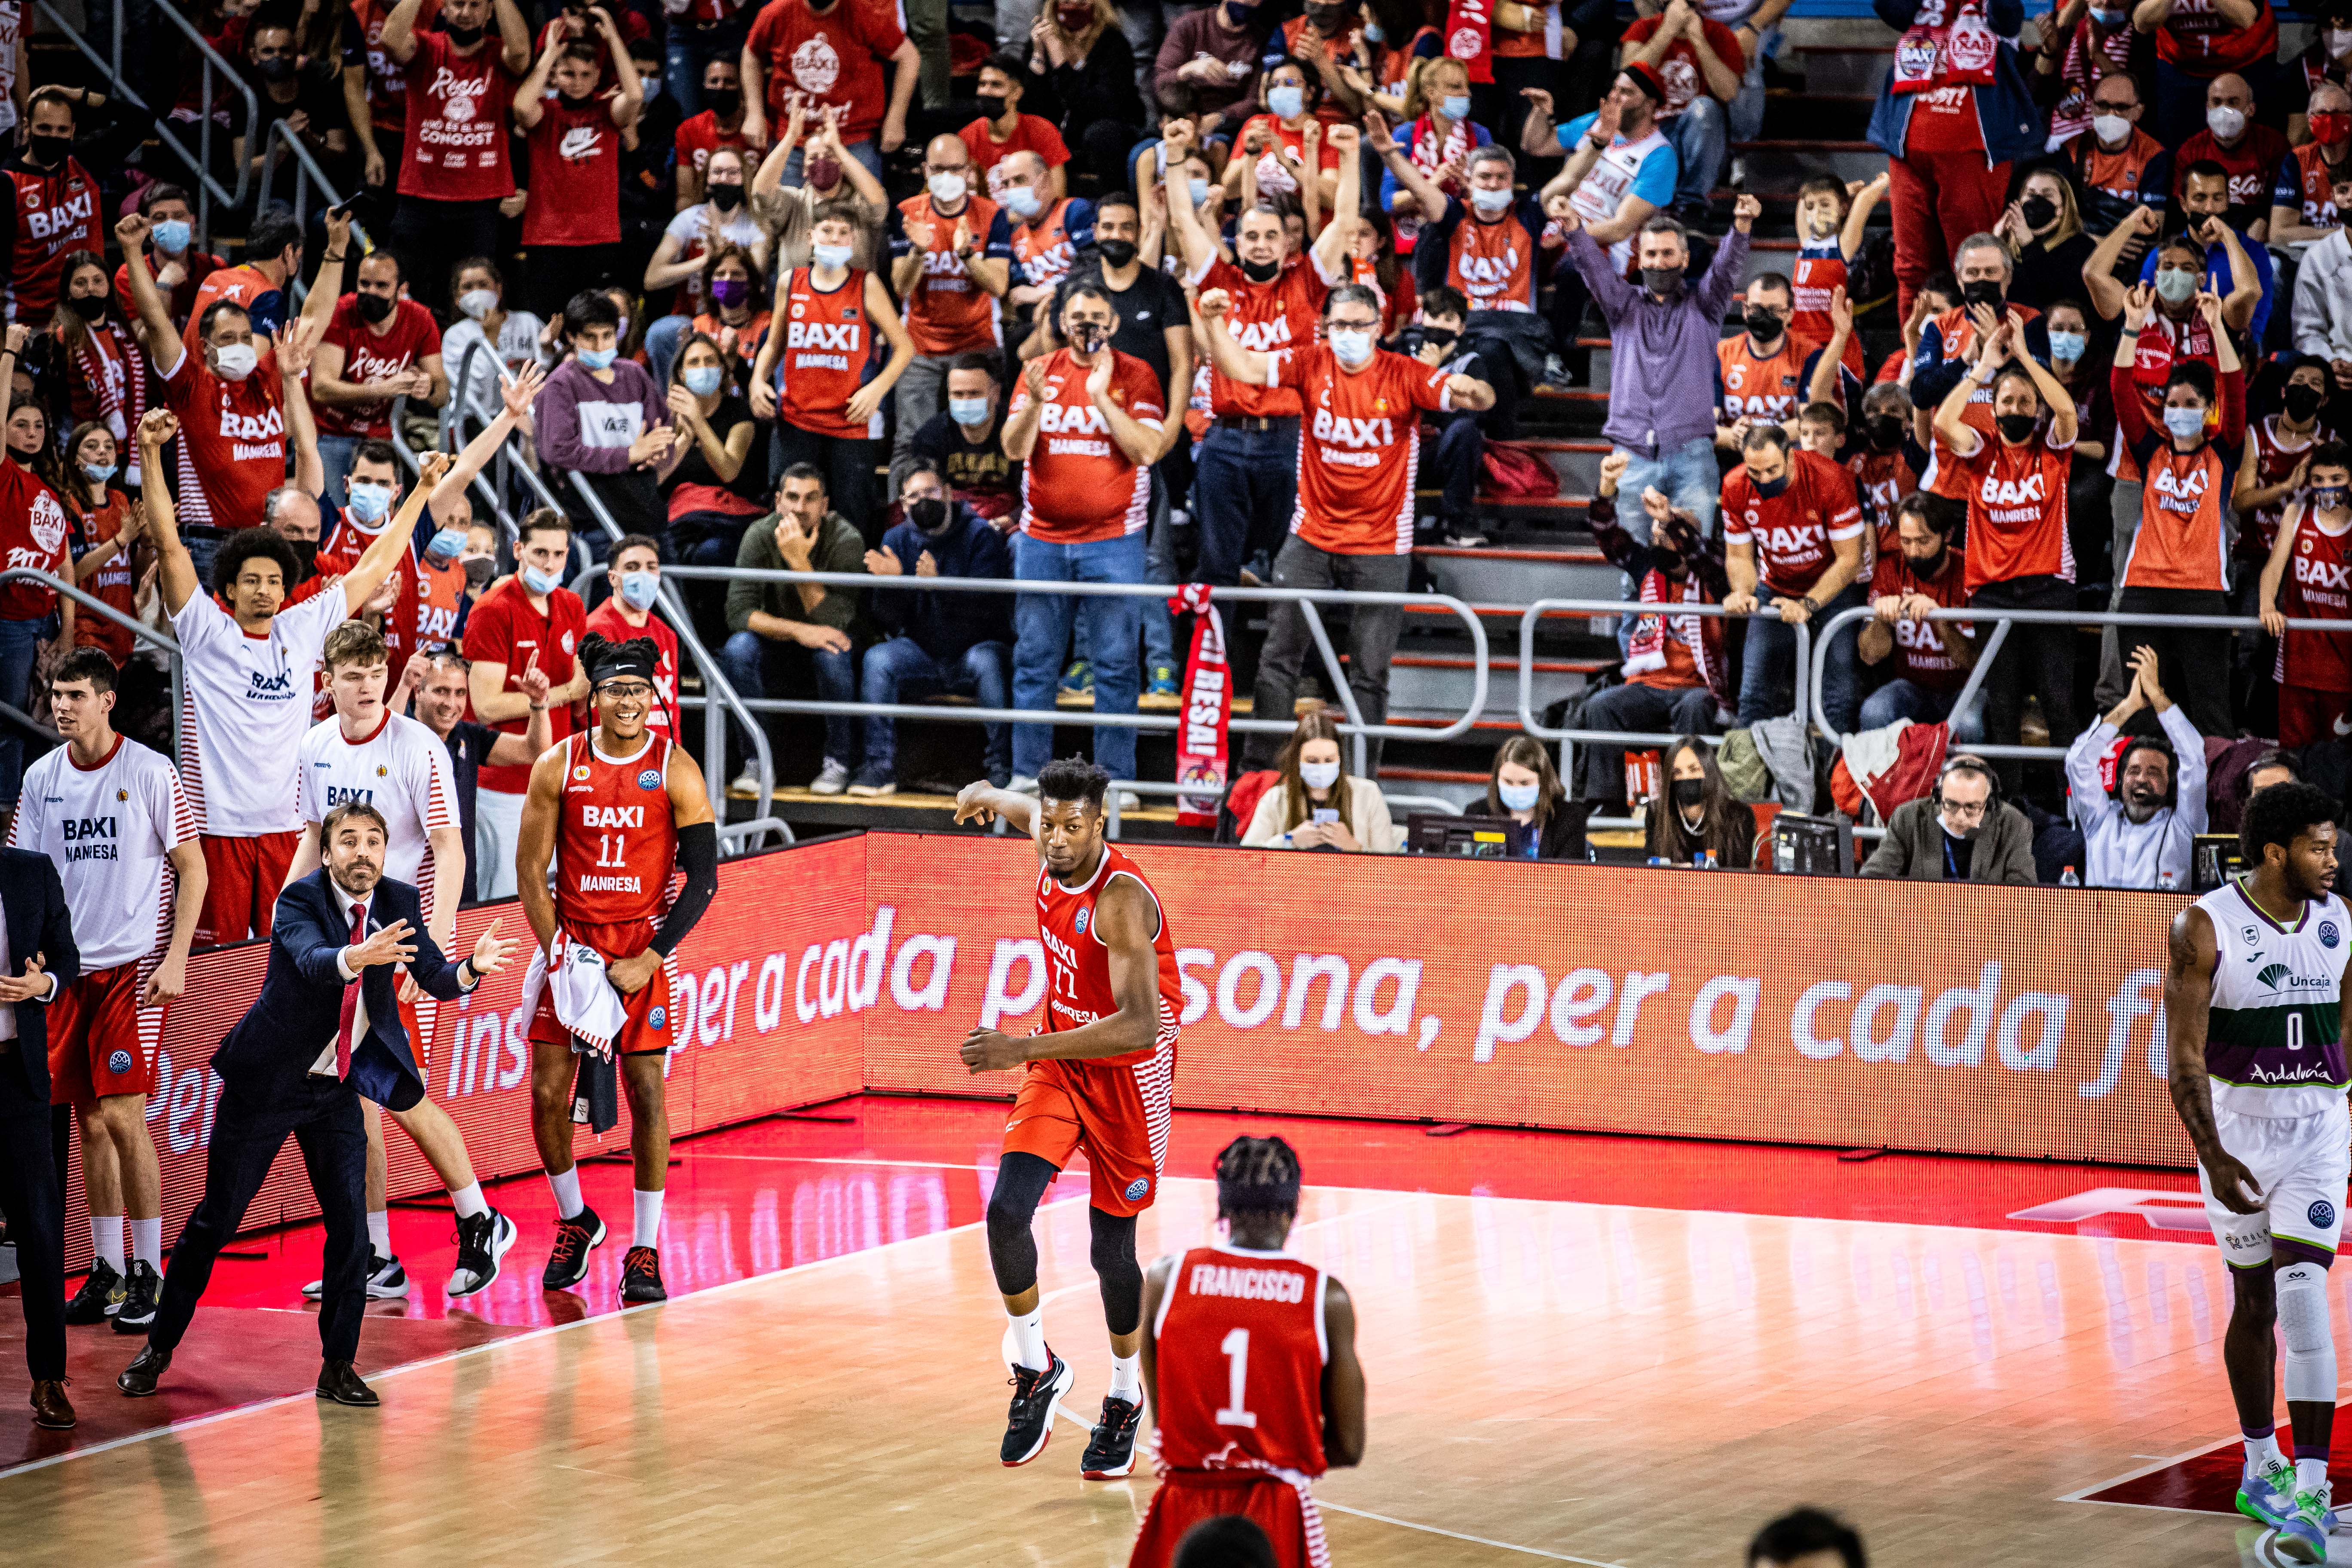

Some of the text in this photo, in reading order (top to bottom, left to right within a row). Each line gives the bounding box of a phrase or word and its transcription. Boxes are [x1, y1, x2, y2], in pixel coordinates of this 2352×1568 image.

[26, 191, 90, 239] BAXI
[788, 322, 859, 352] BAXI
[220, 406, 283, 439] BAXI
[1039, 403, 1108, 435] BAX
[1313, 408, 1393, 448] BAXI
[33, 510, 64, 532] BAXI
[1186, 668, 1224, 757] RESA!
[328, 785, 373, 806] BAXI
[62, 816, 117, 841] BAXI
[583, 805, 644, 828] BAXI
[65, 843, 118, 864] MANRESA
[596, 835, 626, 867] 11
[580, 875, 641, 894] MANRESA
[1041, 925, 1078, 969] BAXI
[664, 958, 748, 1081] per
[755, 952, 787, 1033] a
[794, 905, 958, 1023] cada
[977, 938, 1442, 1052] psona,
[1473, 963, 1670, 1063] per
[1689, 975, 1761, 1054] a
[1792, 959, 2070, 1072] cada
[1053, 962, 1078, 999] 77
[2286, 1013, 2303, 1050] 0
[2250, 1061, 2333, 1083] Andalucía
[1189, 1264, 1305, 1304] FRANCISCO
[1216, 1328, 1257, 1428] 1
